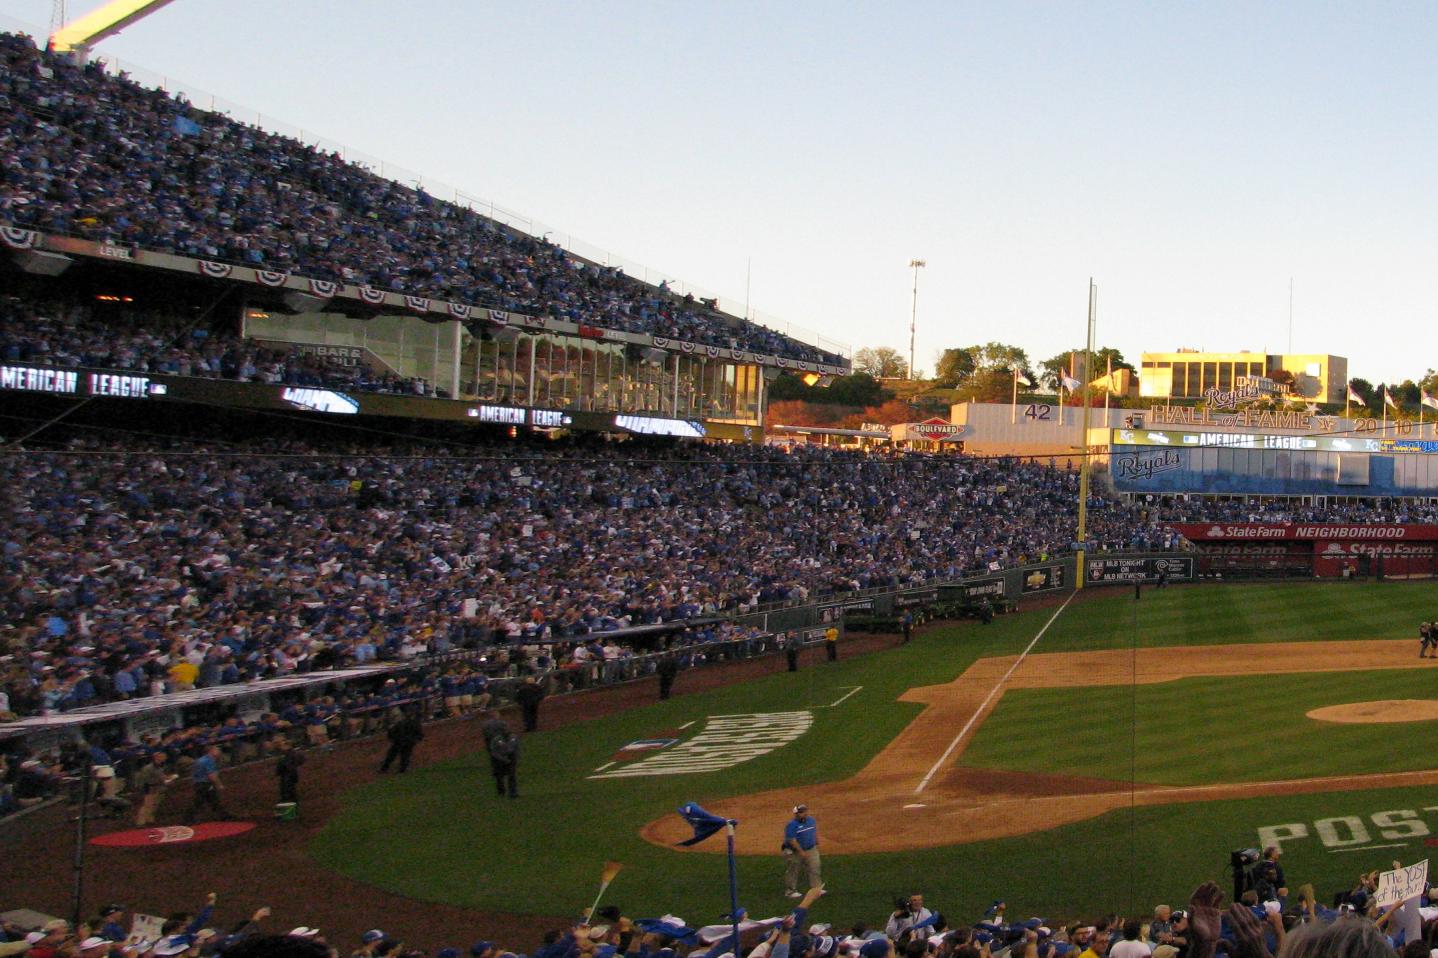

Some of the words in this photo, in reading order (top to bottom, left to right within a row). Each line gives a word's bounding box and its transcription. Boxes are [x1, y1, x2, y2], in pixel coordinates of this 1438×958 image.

[91, 373, 150, 398] LEAGUE
[1204, 383, 1261, 409] Royals
[480, 405, 525, 424] AMERICAN
[531, 410, 563, 427] LEAGUE
[1025, 404, 1051, 421] 42
[1150, 405, 1218, 426] HALL
[1240, 407, 1312, 430] FAME
[915, 425, 958, 434] BOULEVARD
[1354, 417, 1377, 434] 20
[1395, 418, 1413, 435] 10
[1200, 432, 1254, 448] AMERICAN
[1264, 435, 1302, 449] LEAGUE
[1117, 450, 1181, 480] Royals
[1295, 527, 1406, 538] NEIGHBORHOOD
[1382, 871, 1402, 886] The
